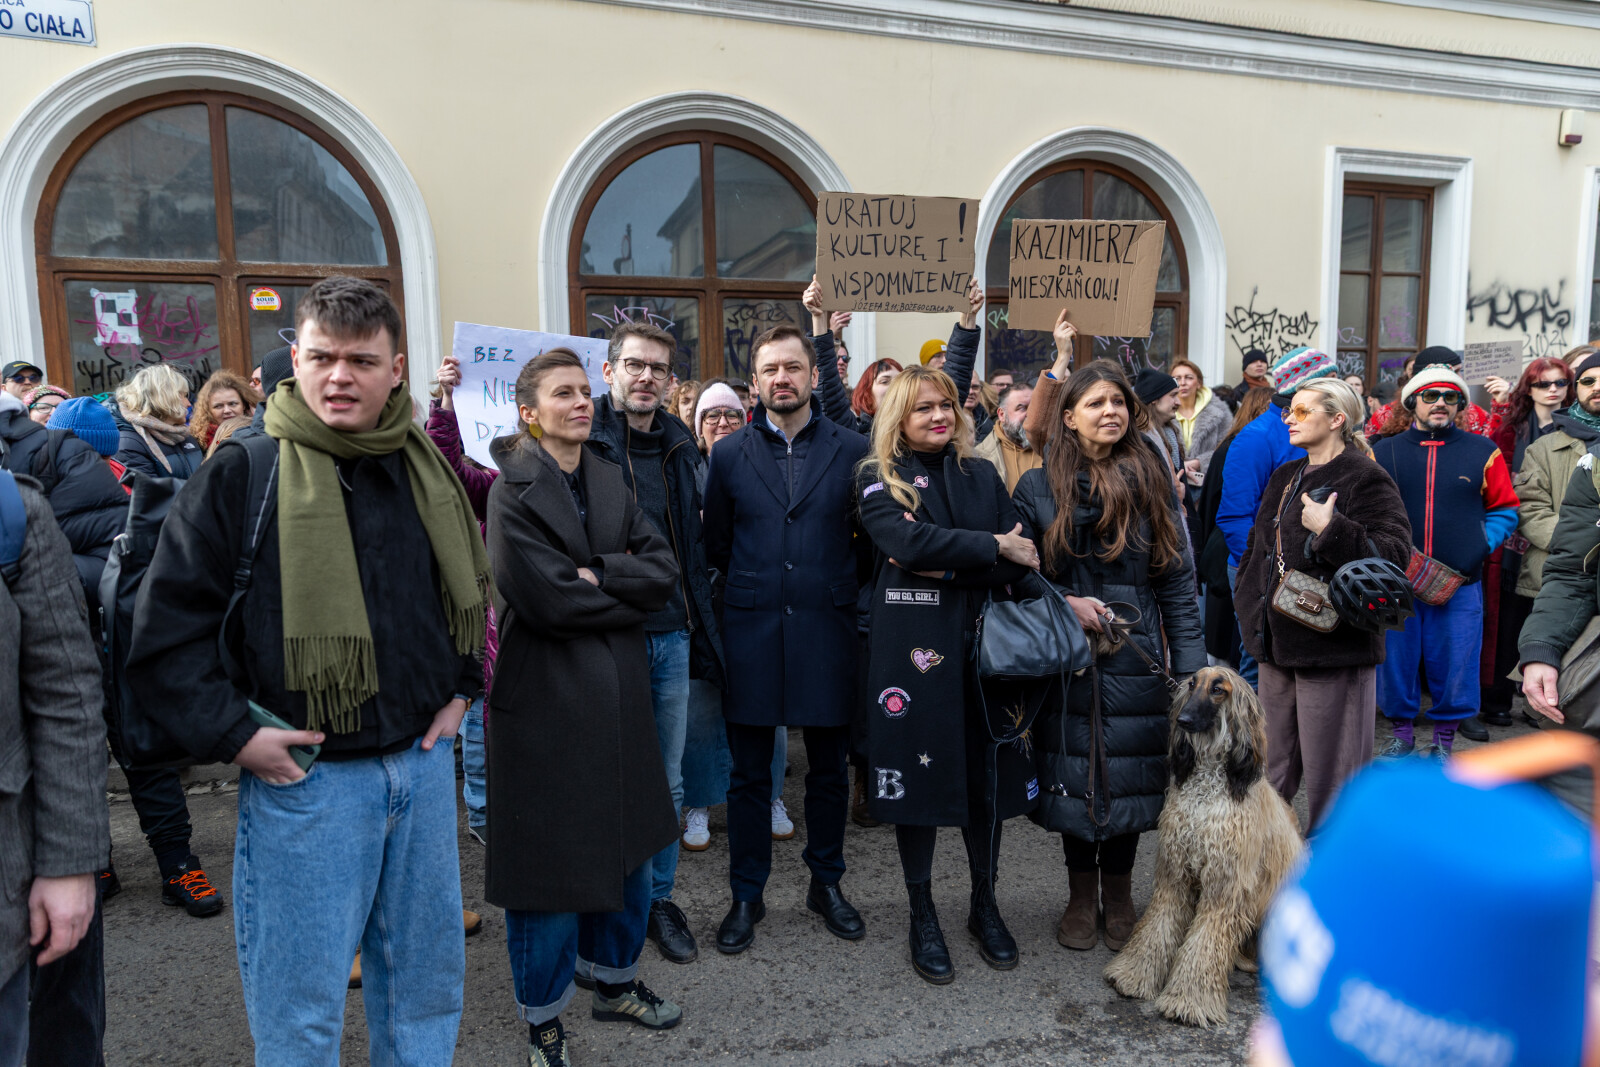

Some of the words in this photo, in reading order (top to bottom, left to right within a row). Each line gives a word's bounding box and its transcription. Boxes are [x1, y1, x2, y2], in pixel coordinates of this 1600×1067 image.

[25, 12, 86, 39] CIAŁA
[830, 233, 927, 262] KULTURĘ
[937, 237, 948, 262] I
[1014, 223, 1138, 265] KAZIMIERZ
[831, 269, 973, 300] WSPOMNIENIA
[1059, 264, 1084, 276] DLA
[470, 346, 516, 363] BEZ
[482, 377, 517, 408] NIE
[887, 591, 901, 601] YOU
[875, 767, 905, 800] B
